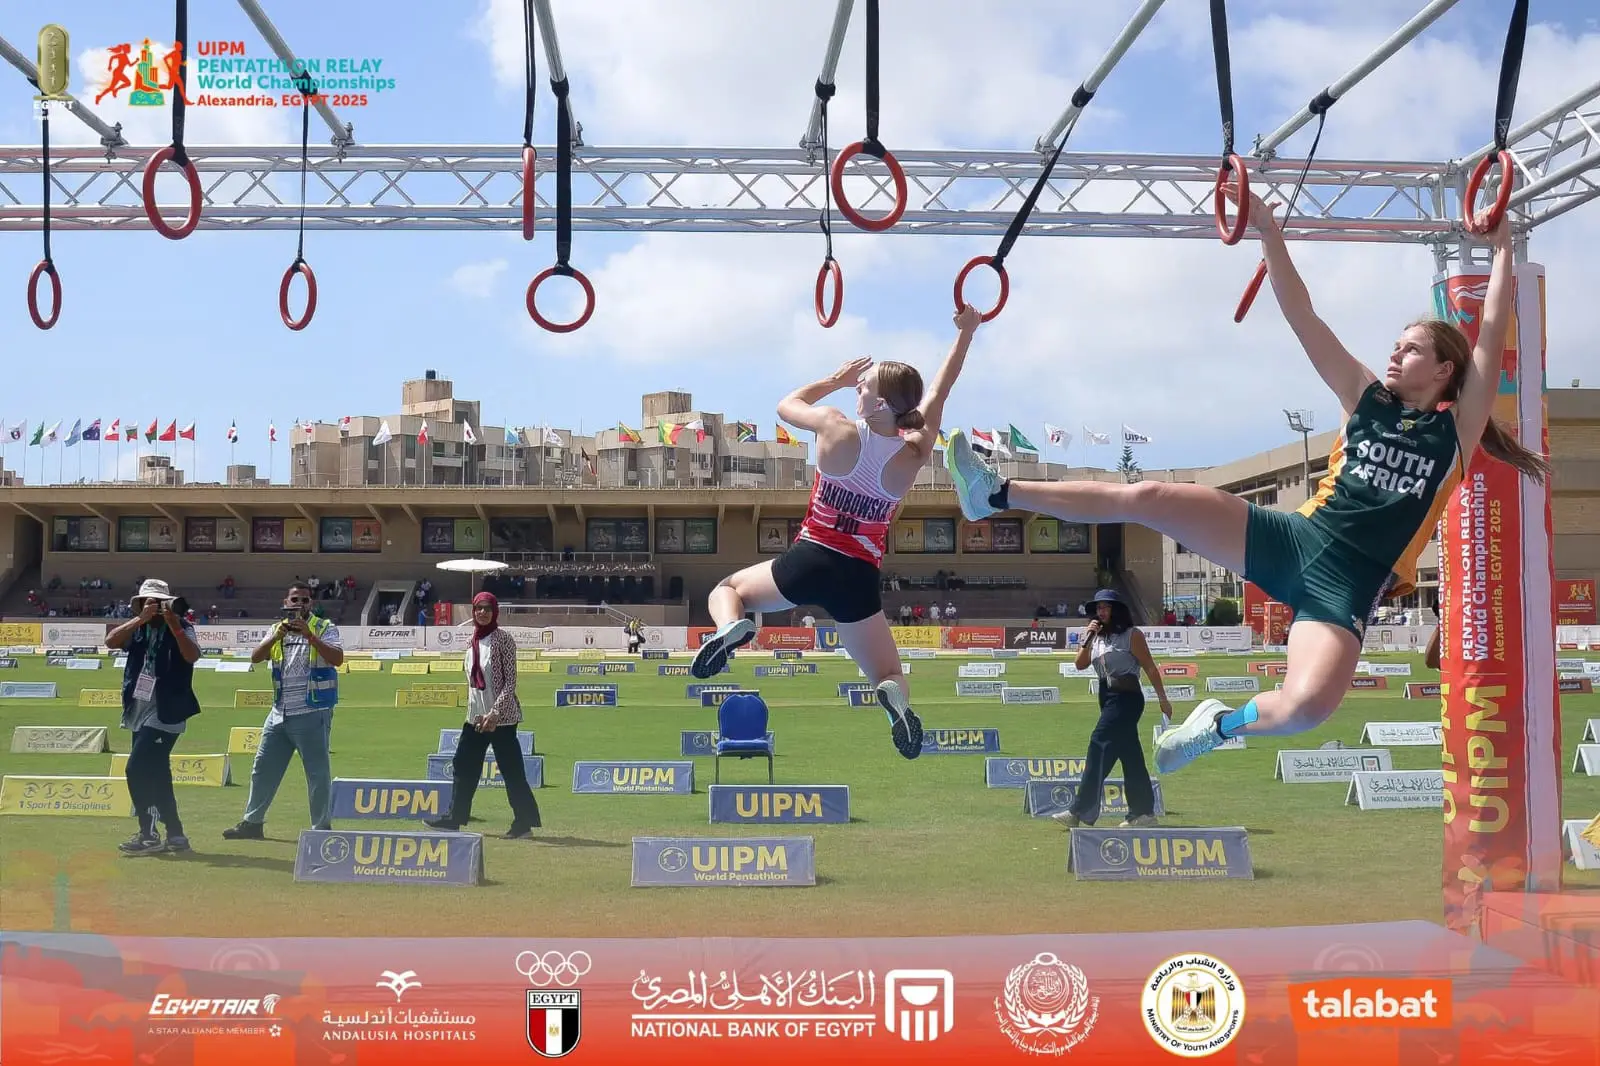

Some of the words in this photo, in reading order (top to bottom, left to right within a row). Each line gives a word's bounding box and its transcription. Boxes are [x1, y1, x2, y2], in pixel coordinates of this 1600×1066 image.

[1357, 440, 1435, 477] SOUTH
[1350, 463, 1426, 499] AFRICA
[1460, 486, 1471, 540] RELAY
[1489, 500, 1501, 534] 2025
[1471, 472, 1488, 605] Championships
[1490, 536, 1502, 581] EGYPT
[1461, 545, 1473, 661] PENTATHLON
[369, 629, 410, 637] EGYPTAIR
[1030, 631, 1057, 641] RAM
[1474, 607, 1488, 661] World
[1490, 584, 1505, 662] Alexandria,
[605, 664, 628, 672] UIPM
[664, 667, 689, 675] UIPM
[794, 665, 810, 673] IPM
[567, 693, 605, 705] UIPM
[936, 731, 984, 745] UIPM
[1028, 759, 1086, 776] UIPM
[1465, 685, 1510, 832] UIPM
[613, 768, 674, 785] UIPM
[27, 801, 51, 811] Sport
[54, 801, 60, 809] 5
[62, 801, 111, 811] Disciplines
[354, 788, 439, 815] UIPM
[736, 793, 823, 818] UIPM
[354, 836, 449, 867] UIPM
[692, 845, 788, 872] UIPM
[1132, 838, 1227, 866] UIPM
[353, 865, 385, 876] World
[388, 866, 447, 878] Pentathlon
[694, 872, 727, 881] World
[729, 872, 788, 881] Pentathlon
[1137, 867, 1169, 876] World
[1171, 866, 1228, 876] Pentathlon
